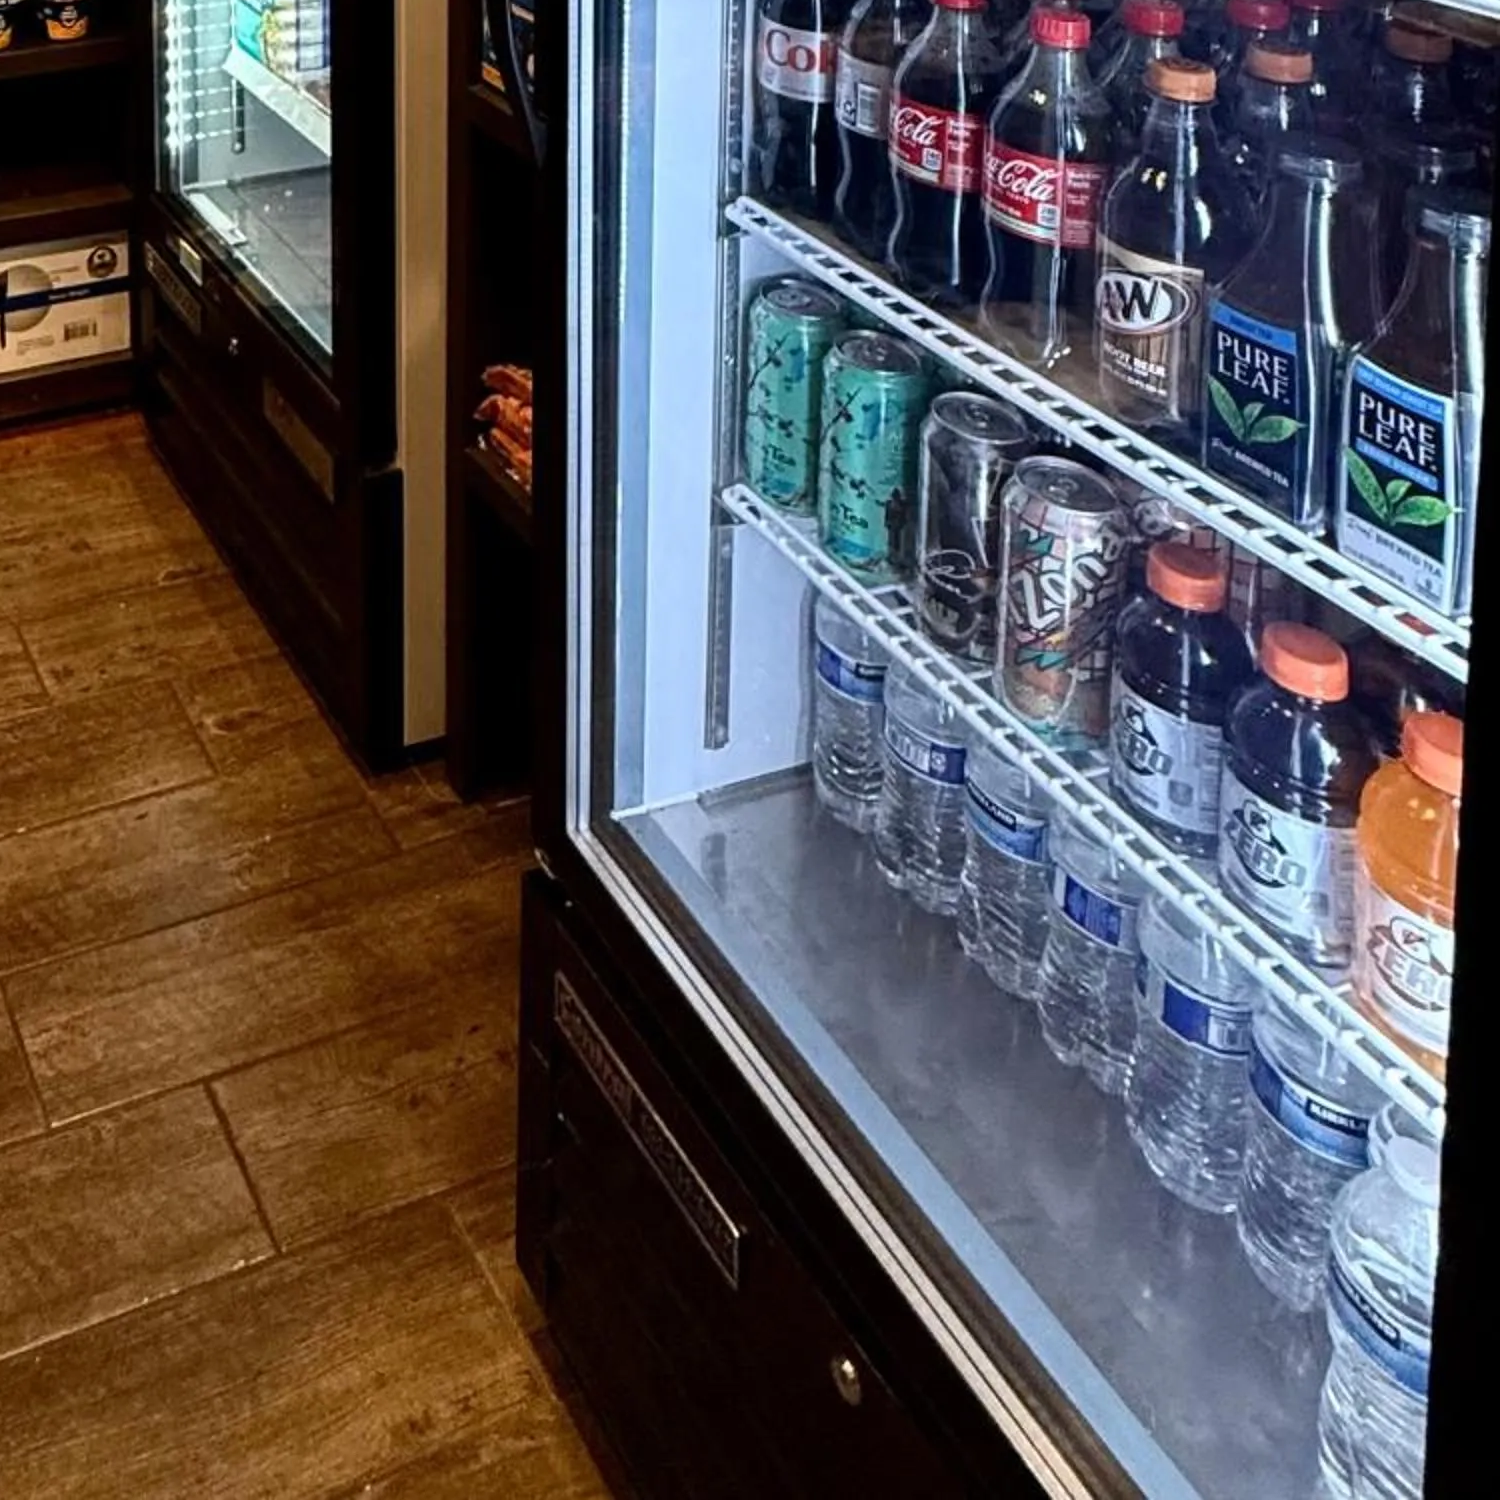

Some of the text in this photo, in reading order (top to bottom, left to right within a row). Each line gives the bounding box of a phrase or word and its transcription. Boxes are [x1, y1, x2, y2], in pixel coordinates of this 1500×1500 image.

[1217, 330, 1290, 381] PURE
[1218, 353, 1291, 401] LEAF
[1358, 412, 1437, 468] LEAF
[1359, 391, 1436, 448] PURE
